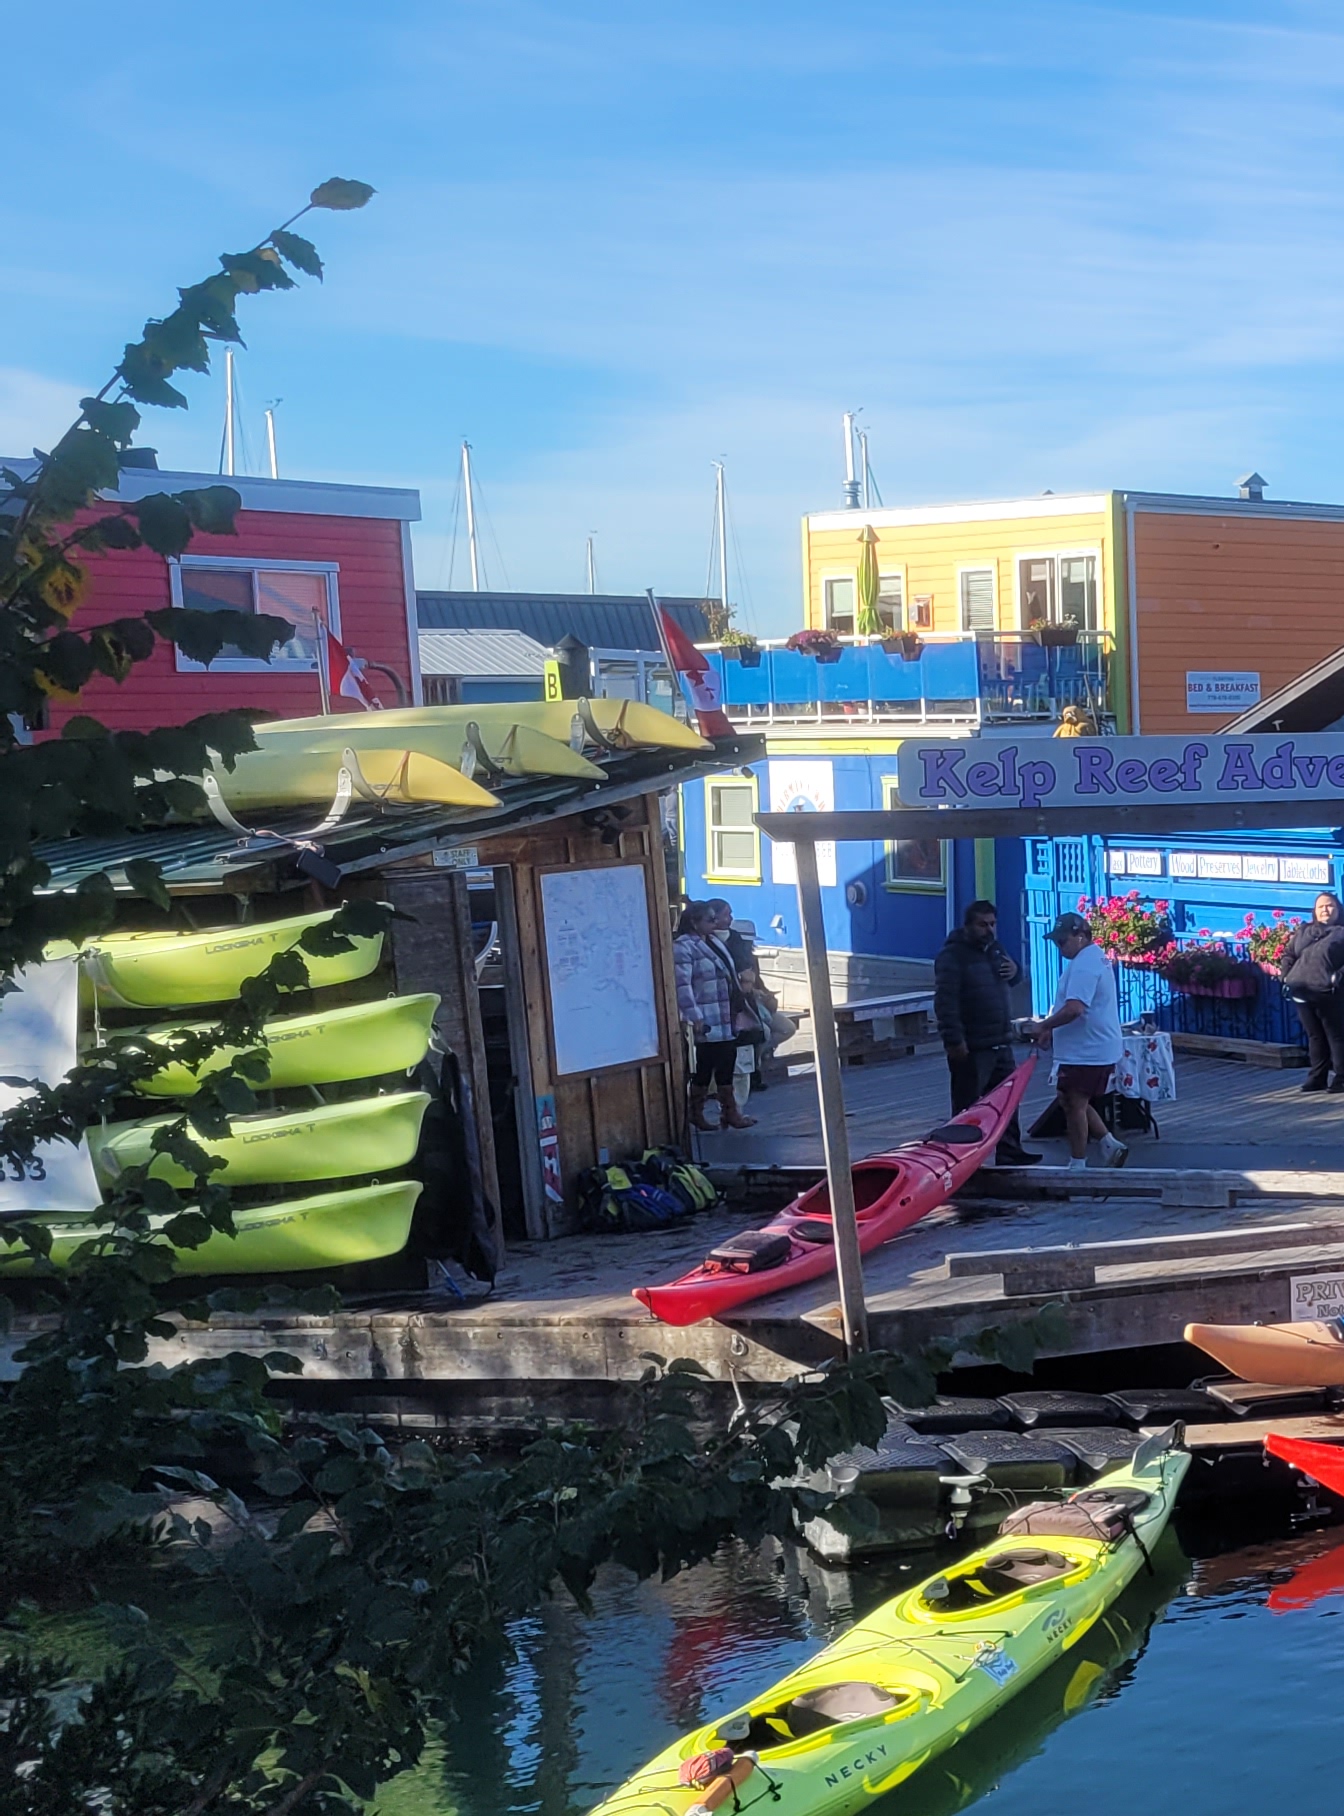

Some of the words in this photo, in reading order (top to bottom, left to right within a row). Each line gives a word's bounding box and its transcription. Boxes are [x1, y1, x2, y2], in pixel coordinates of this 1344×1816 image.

[547, 672, 558, 699] B
[1187, 683, 1204, 692] BED
[1205, 683, 1213, 692] &
[1214, 683, 1259, 692] BREAKFAST
[918, 746, 1057, 808] Kelp
[1073, 743, 1208, 794] Reef
[1129, 853, 1158, 872] Pottery
[1171, 854, 1195, 874] Wood
[1200, 856, 1241, 875] Preserves
[1246, 858, 1276, 879] Jewelry
[1282, 860, 1327, 881] Tablecloths
[269, 933, 279, 942] T
[316, 1025, 325, 1034] T
[306, 1123, 316, 1133] T
[1316, 1303, 1344, 1318] Not
[1046, 1616, 1073, 1644] NECKY
[824, 1744, 887, 1788] NECKY
